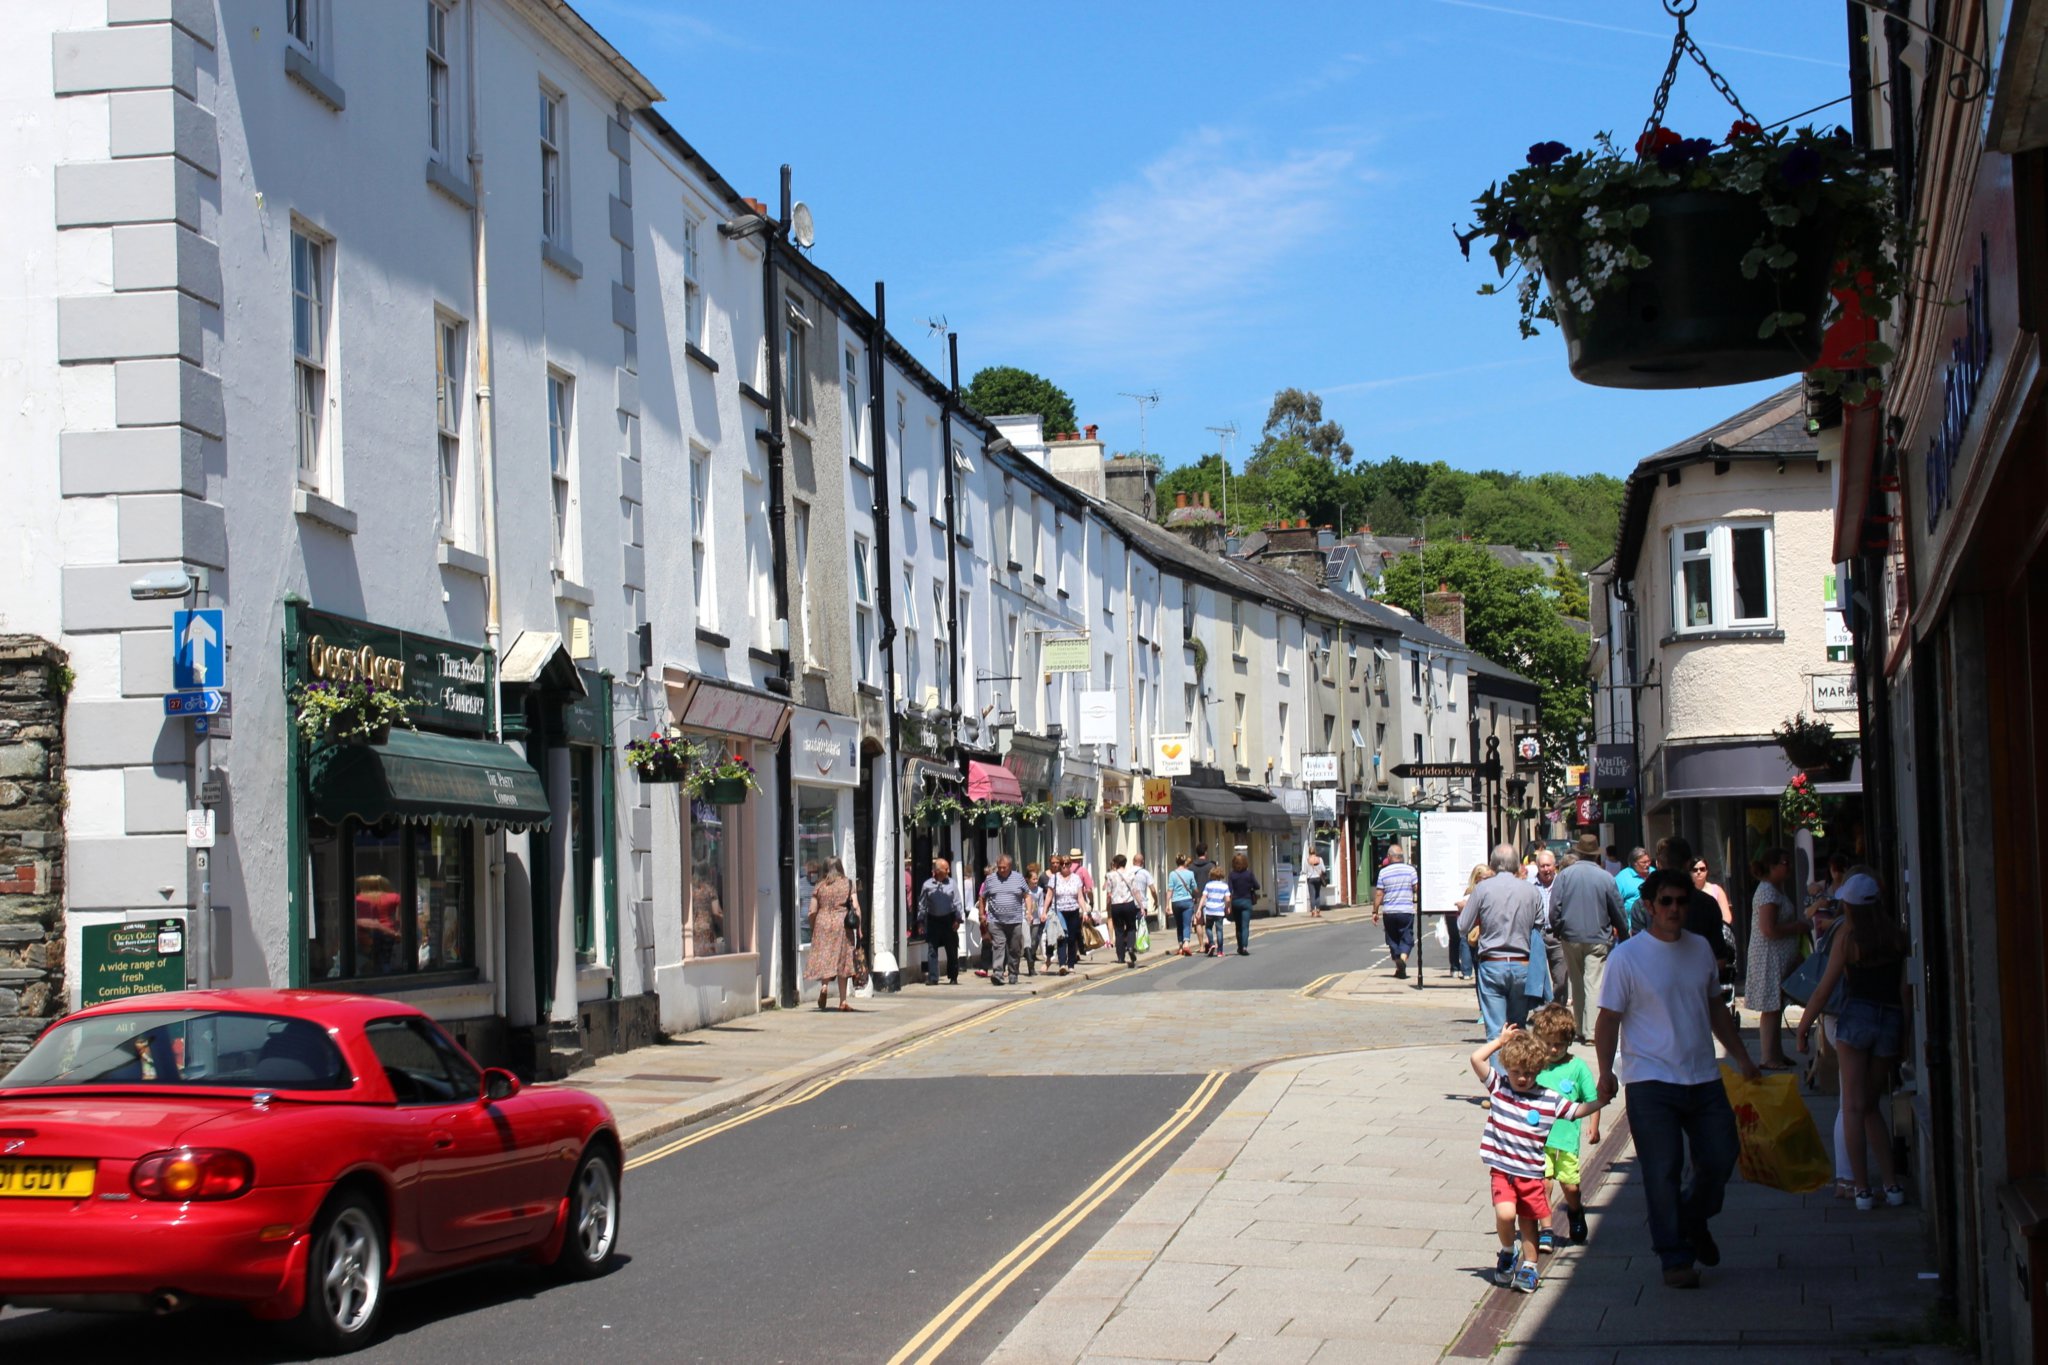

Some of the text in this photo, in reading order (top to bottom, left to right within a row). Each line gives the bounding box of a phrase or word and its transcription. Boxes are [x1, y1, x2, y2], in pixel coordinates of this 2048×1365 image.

[1818, 686, 1855, 698] MARK
[170, 701, 180, 709] 27
[1409, 766, 1477, 778] Paddons Row
[199, 858, 205, 867] 3
[99, 958, 167, 972] A wide range of
[121, 972, 144, 982] fresh
[99, 983, 166, 996] Cornish Pasties,
